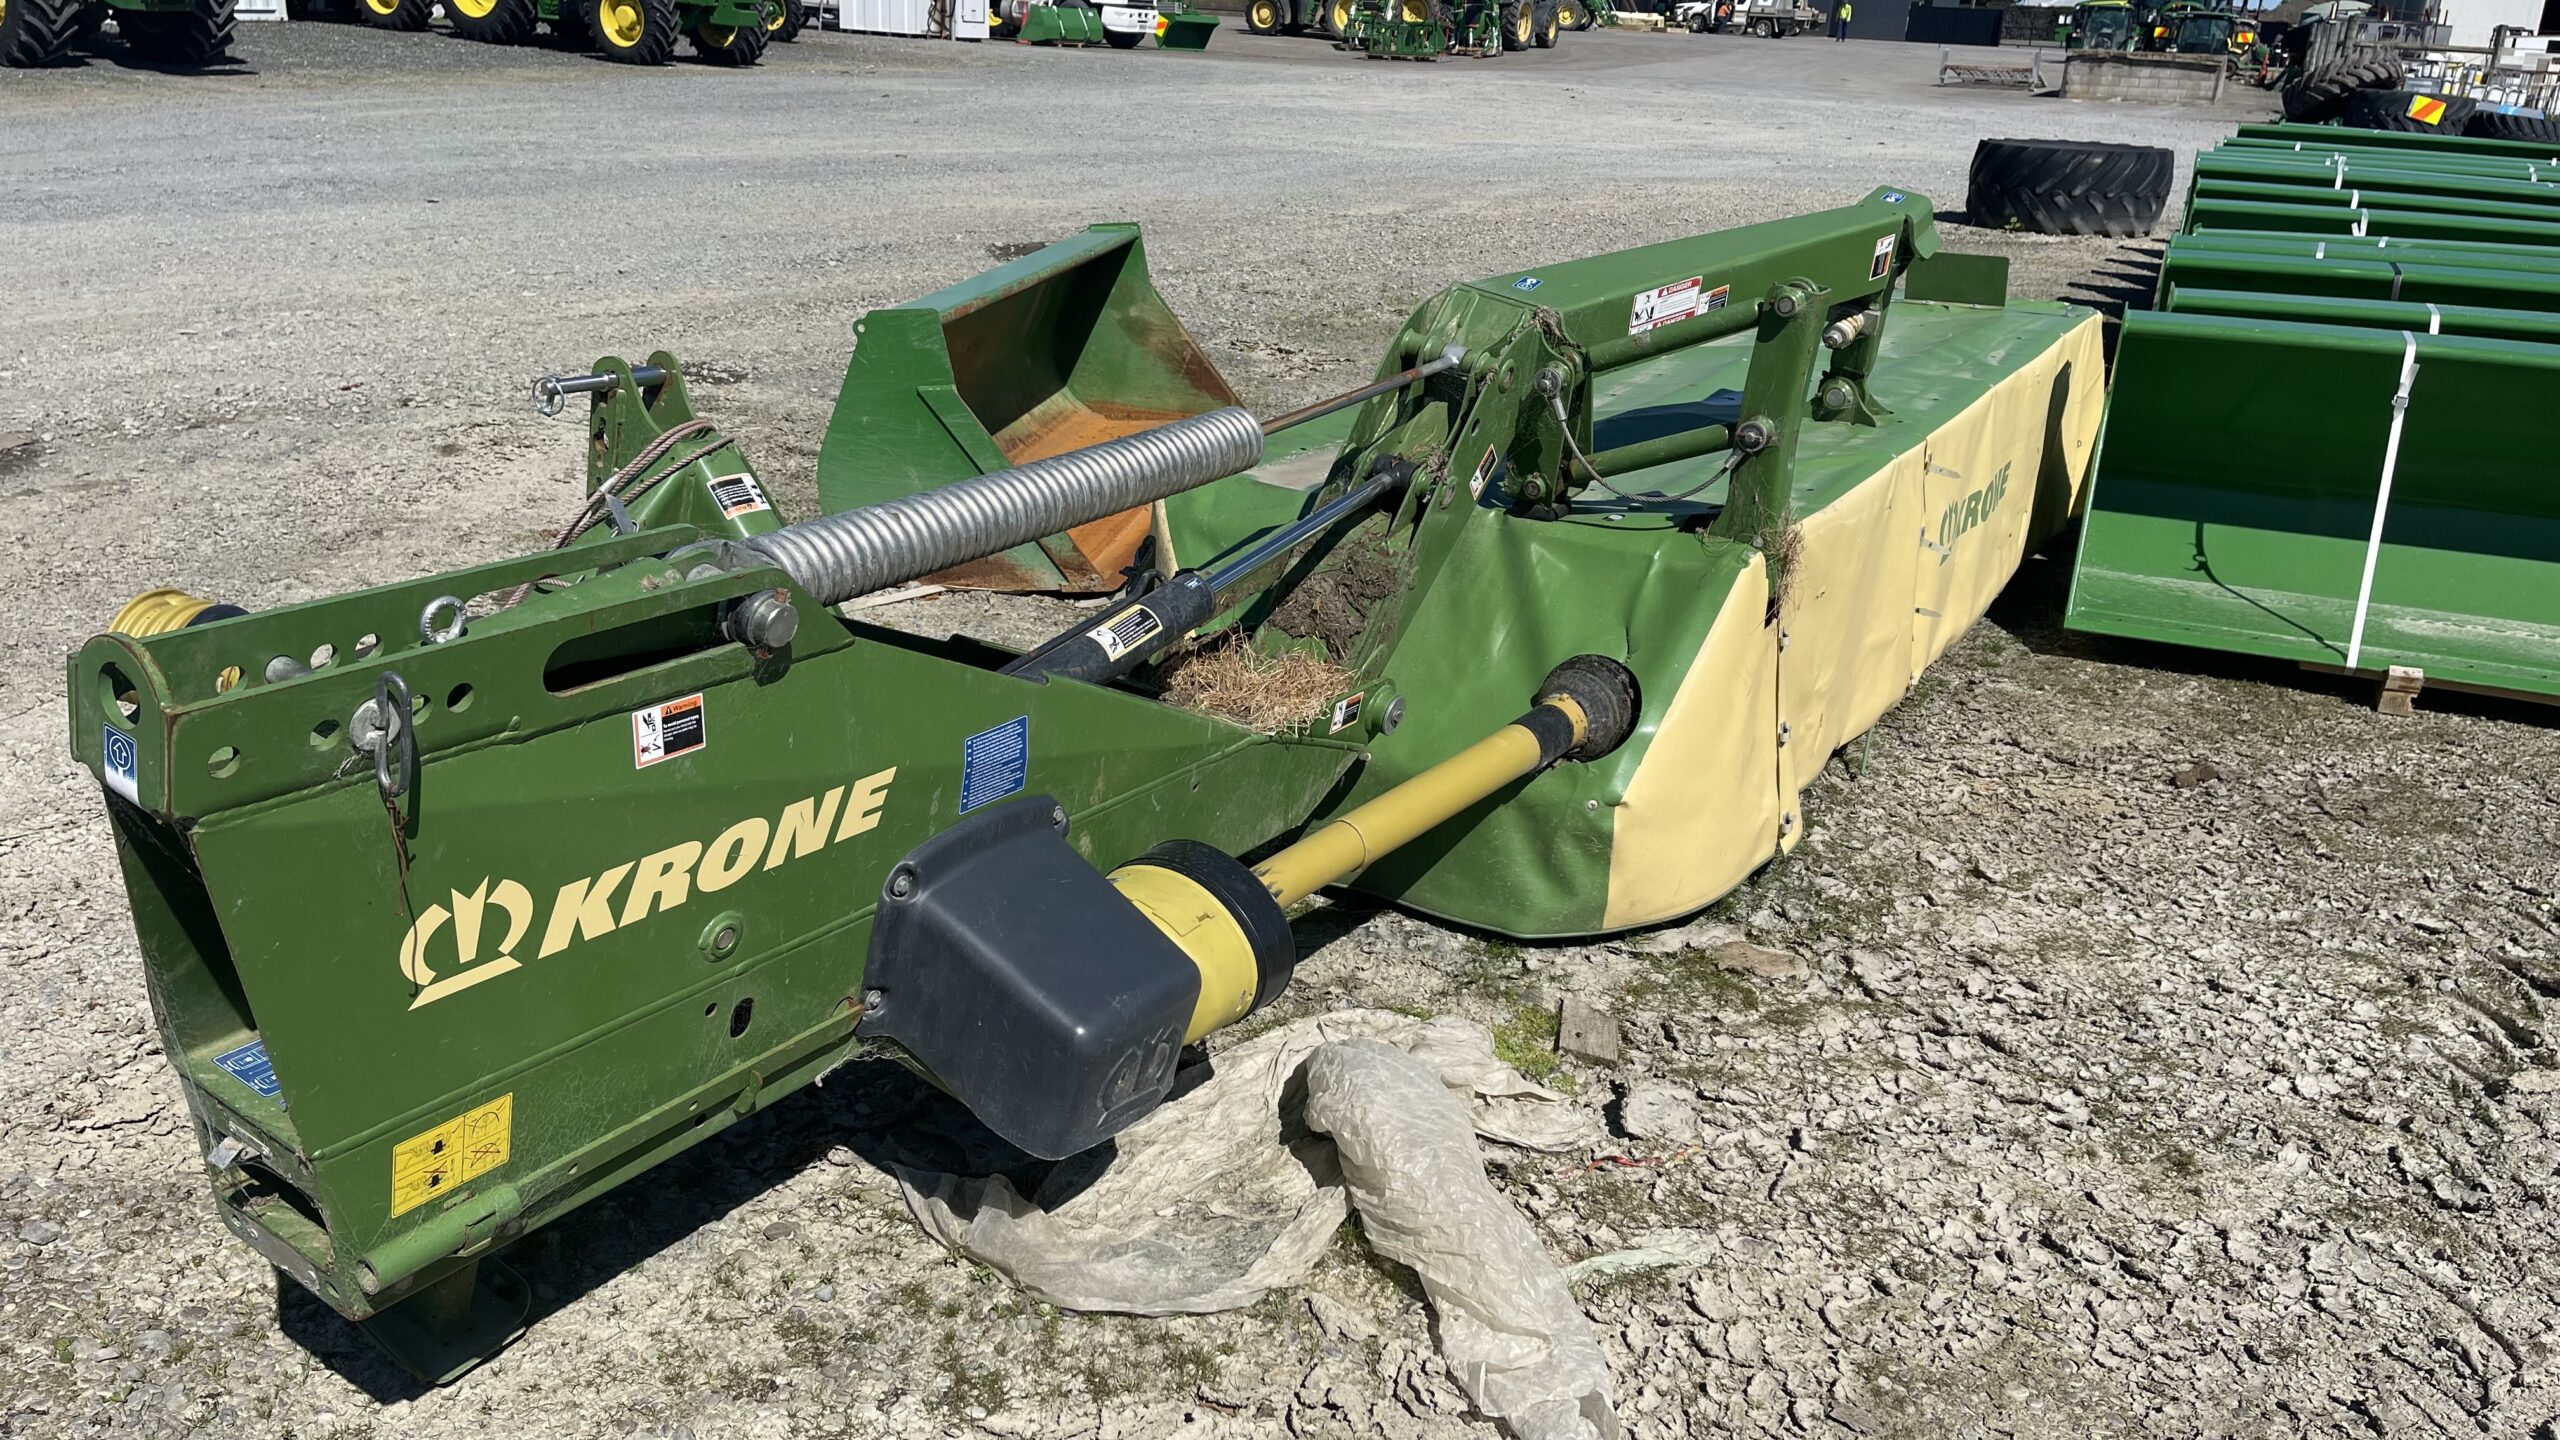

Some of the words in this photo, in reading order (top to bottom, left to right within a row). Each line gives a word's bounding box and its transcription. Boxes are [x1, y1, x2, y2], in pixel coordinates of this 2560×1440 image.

[1668, 281, 1692, 293] DANGER
[1953, 460, 2013, 543] KRONE
[673, 701, 697, 711] Warning
[537, 766, 898, 960] KRONE
